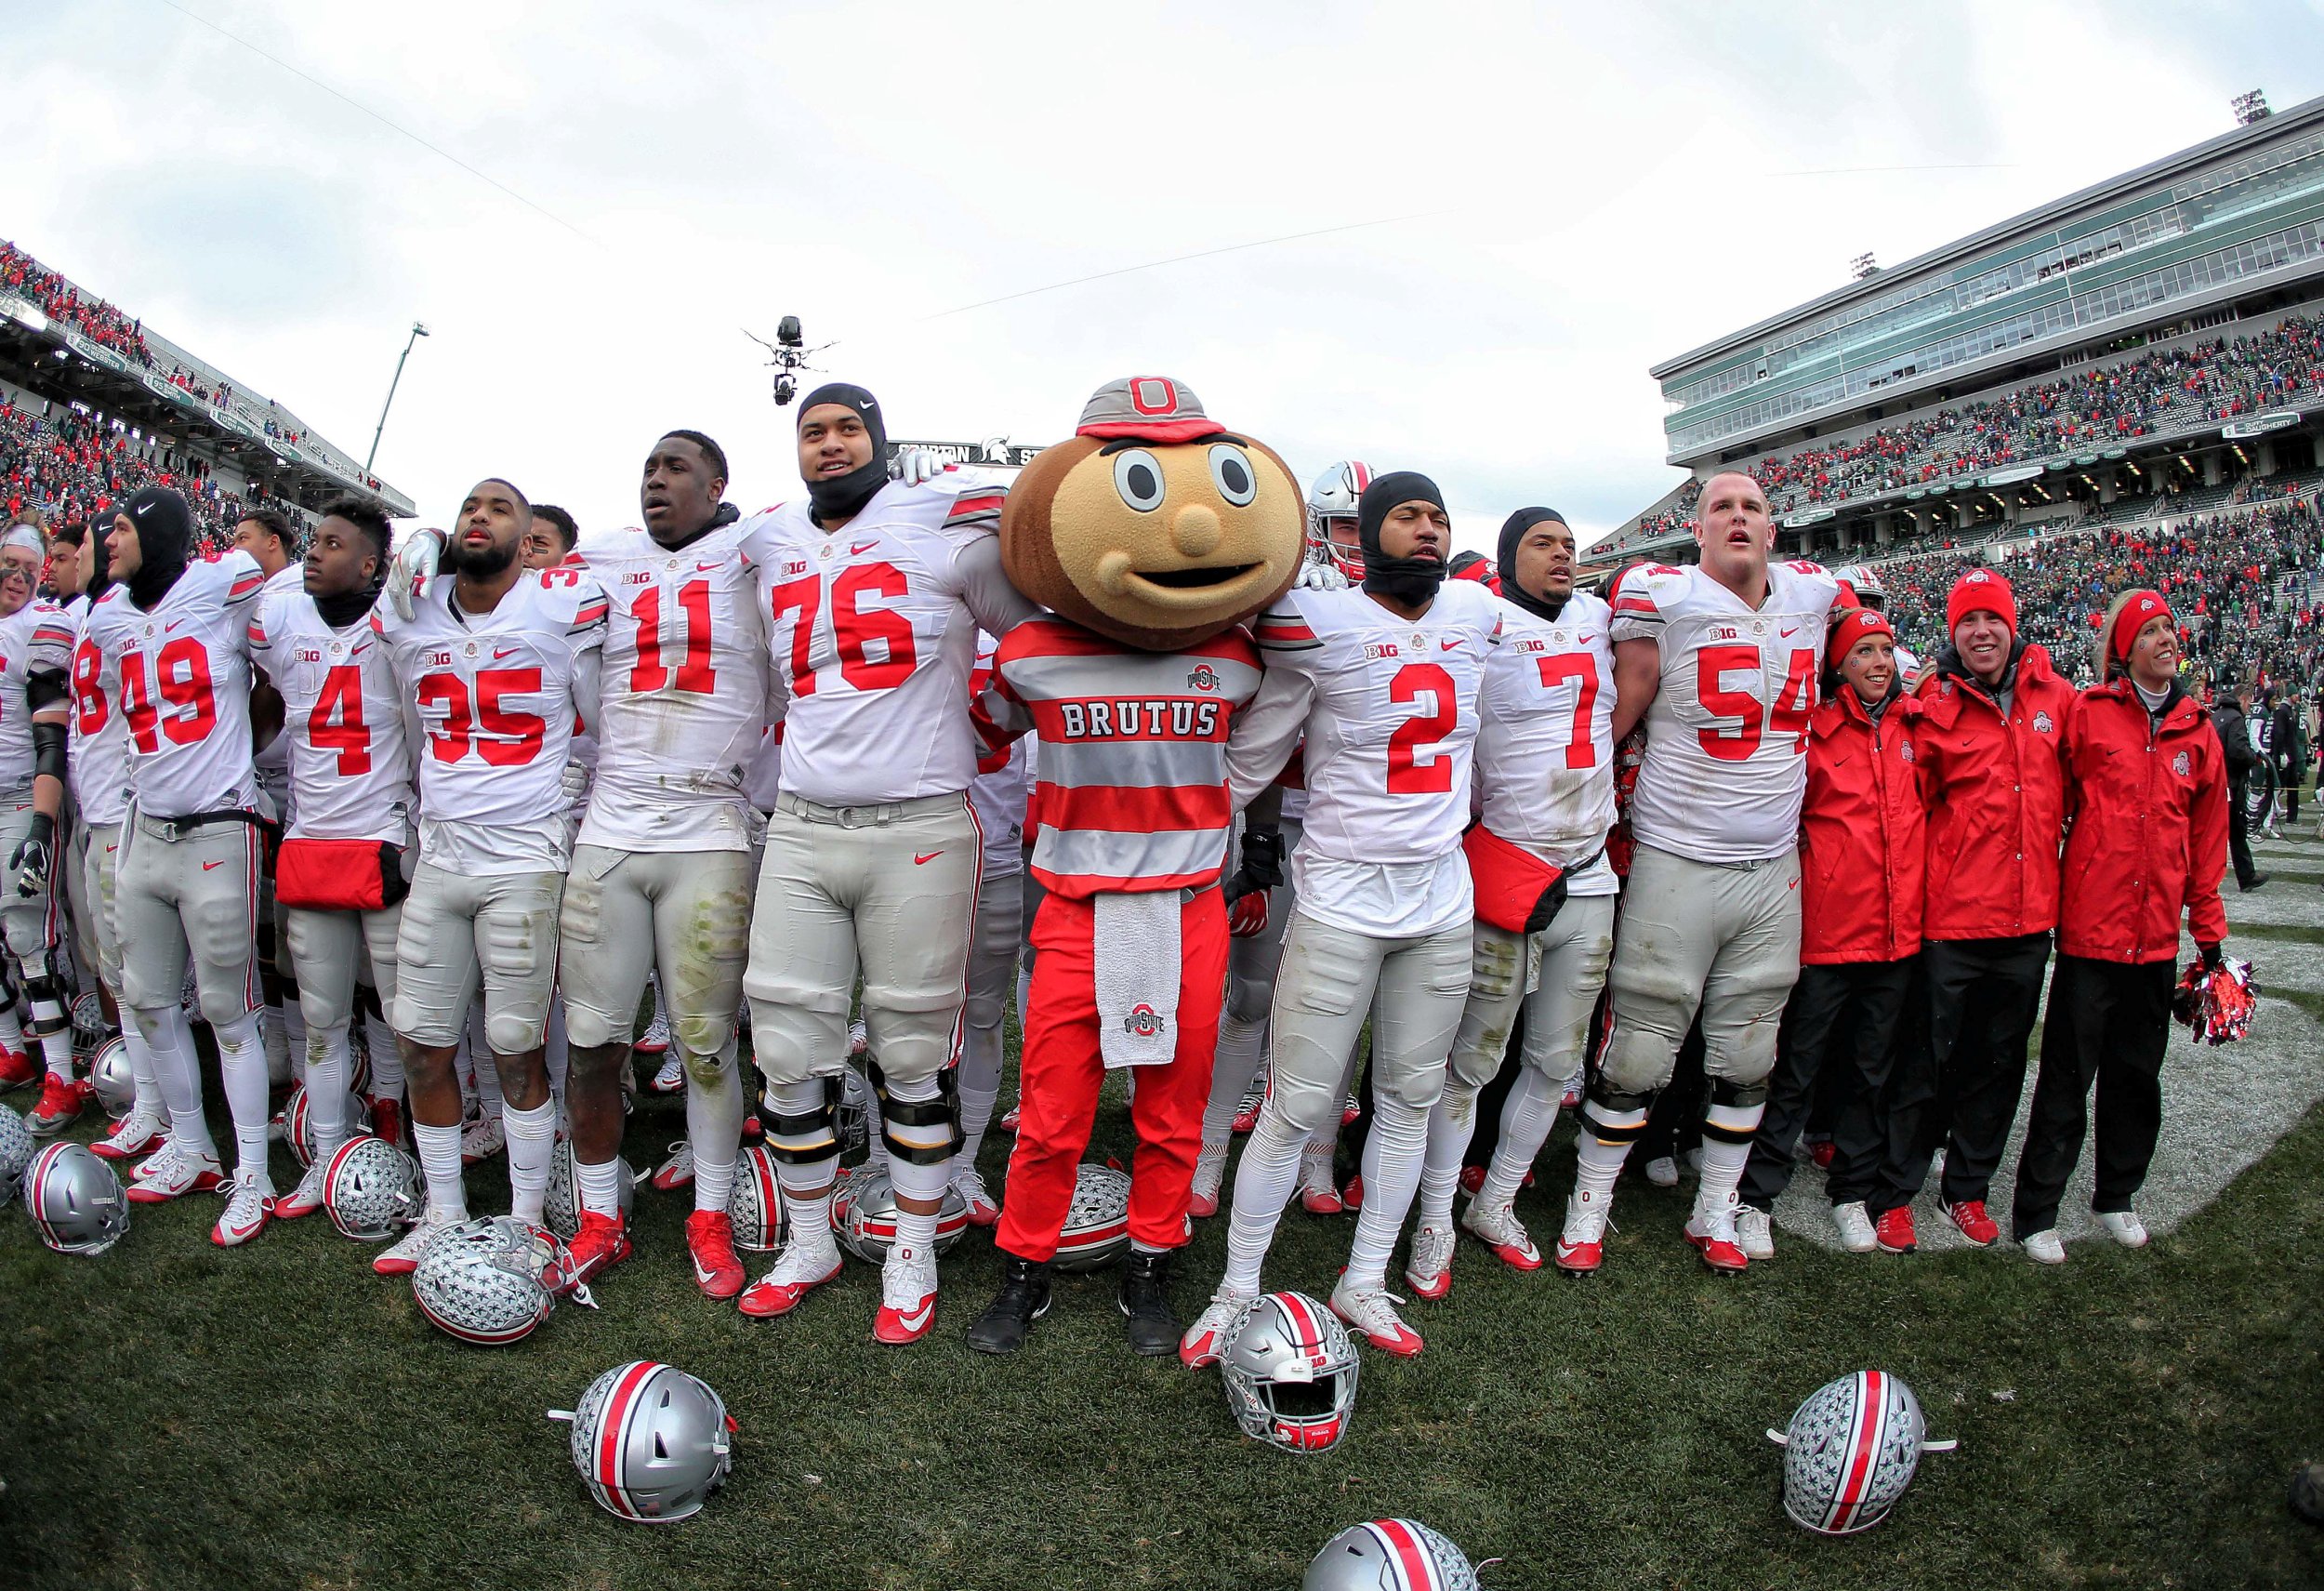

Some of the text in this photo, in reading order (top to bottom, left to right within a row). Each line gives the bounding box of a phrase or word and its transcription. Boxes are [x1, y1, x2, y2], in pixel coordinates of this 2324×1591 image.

[90, 350, 120, 369] WEBSTER
[153, 379, 164, 390] 95
[164, 389, 181, 401] SMITH
[1128, 377, 1179, 417] O
[2246, 419, 2291, 433] DAUGHERTY
[630, 578, 717, 695] 11
[771, 561, 918, 699] 76
[120, 635, 218, 754] 49
[308, 664, 372, 777] 4
[416, 667, 547, 767] 35
[1060, 700, 1220, 738] BRUTUS
[1386, 663, 1458, 794] 2
[1536, 653, 1600, 770] 7
[1697, 645, 1817, 761] 54
[2251, 706, 2262, 714] 27
